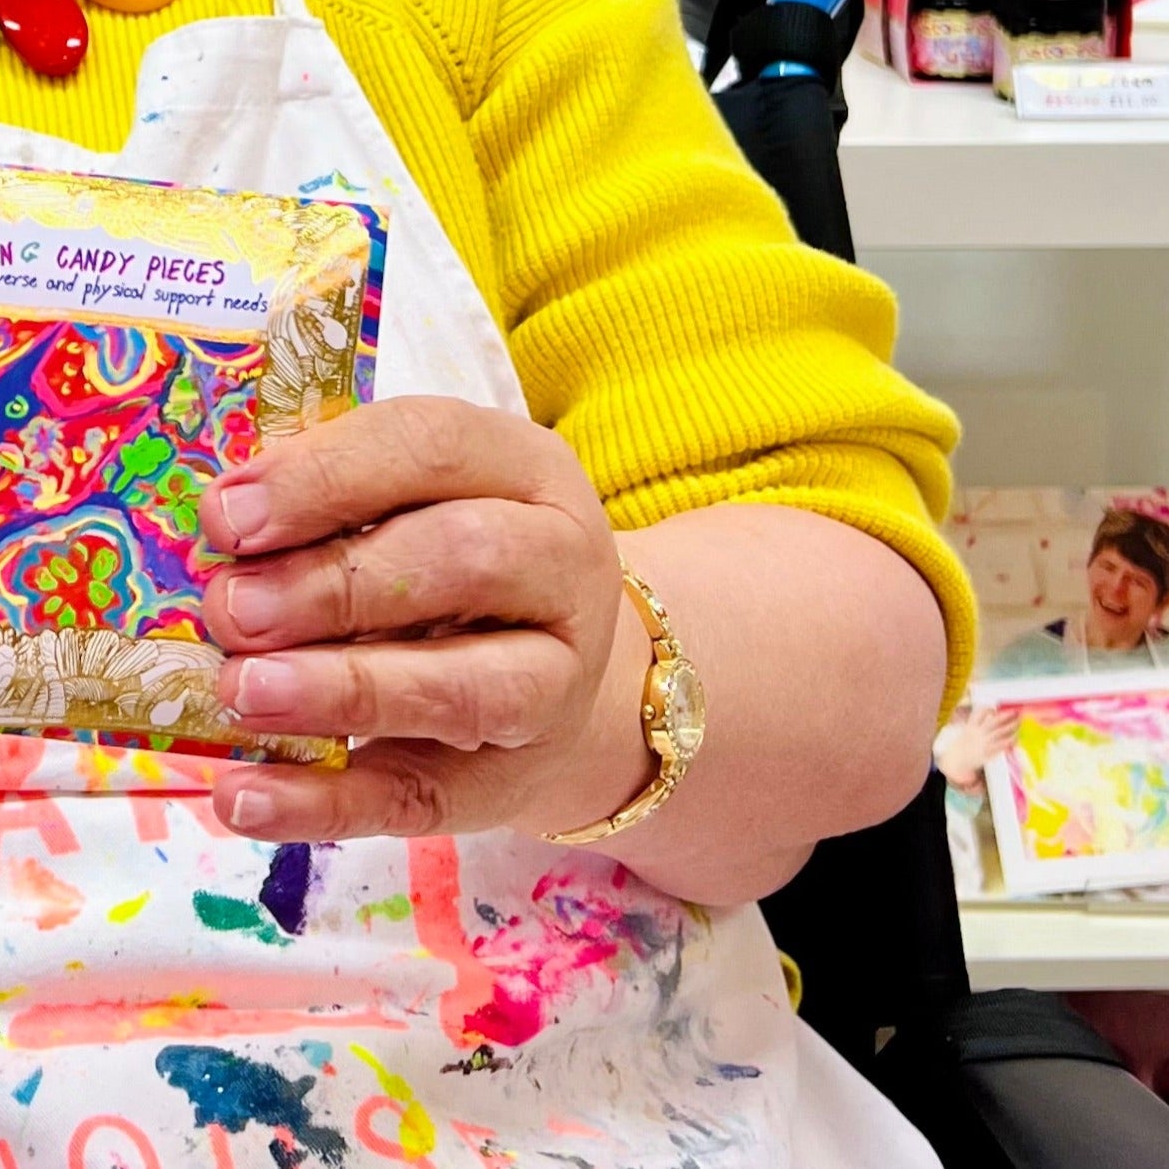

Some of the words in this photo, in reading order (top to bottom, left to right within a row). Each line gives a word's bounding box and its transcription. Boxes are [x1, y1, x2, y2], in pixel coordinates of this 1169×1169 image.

[57, 245, 135, 274] CANDY
[146, 255, 226, 285] PIECES
[47, 274, 79, 294] and
[83, 277, 146, 304] physical
[154, 285, 215, 315] support
[224, 293, 268, 314] needs
